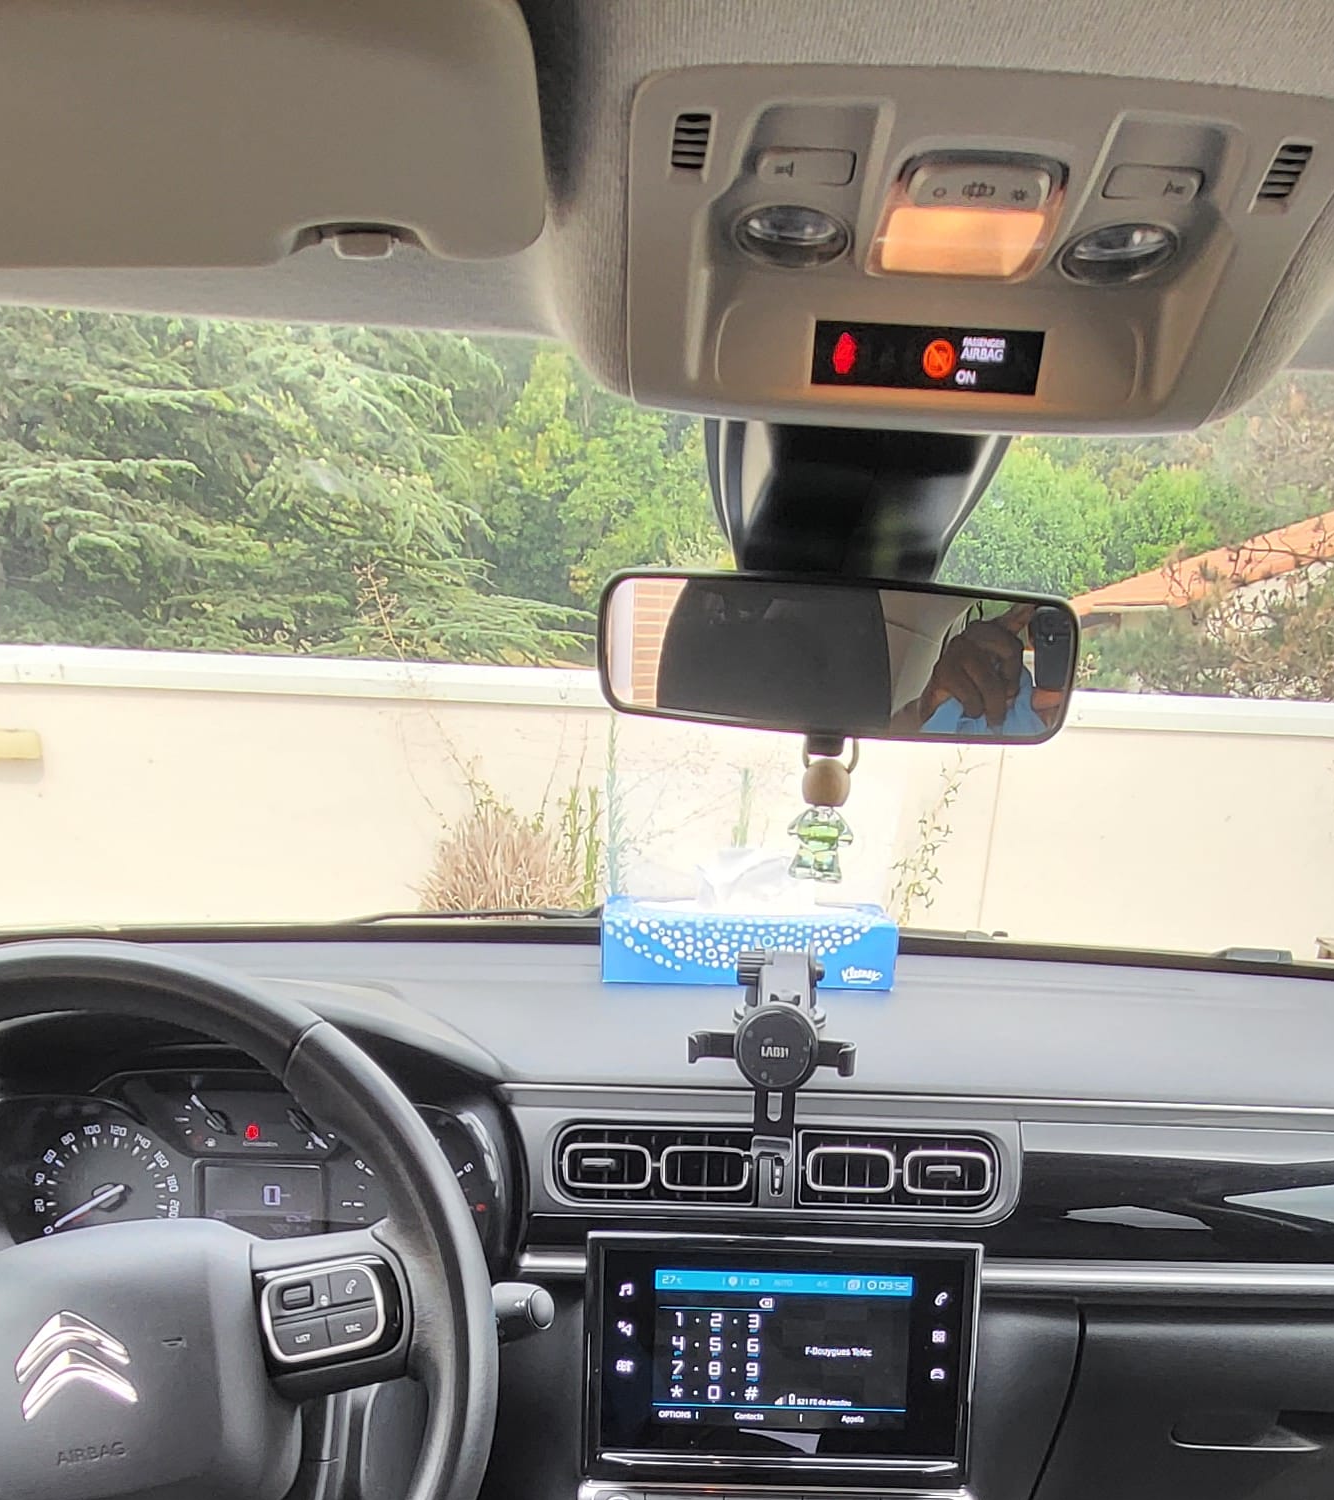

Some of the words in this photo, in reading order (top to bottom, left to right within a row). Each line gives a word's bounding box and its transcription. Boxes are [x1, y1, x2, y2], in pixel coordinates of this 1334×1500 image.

[962, 336, 1006, 348] PASSENGER
[960, 346, 1004, 362] AIRBAG
[955, 369, 976, 385] ON
[841, 966, 883, 982] Kleenex
[83, 1124, 101, 1135] 100
[110, 1125, 127, 1137] 120
[60, 1132, 76, 1146] 80
[135, 1133, 151, 1149] 140
[43, 1149, 57, 1164] 60
[153, 1151, 169, 1168] 160
[35, 1172, 45, 1186] 40
[166, 1175, 179, 1193] 180
[263, 1185, 281, 1206] 0
[34, 1199, 44, 1213] 20
[168, 1199, 180, 1218] 200
[675, 1312, 682, 1327] 1
[710, 1313, 723, 1328] 2
[747, 1313, 760, 1328] 3
[672, 1336, 684, 1351] 4
[709, 1337, 721, 1352] 5
[747, 1338, 759, 1352] 6
[671, 1360, 683, 1374] 7
[709, 1361, 721, 1376] 8
[746, 1362, 758, 1377] 9
[707, 1385, 720, 1400] 0
[658, 1410, 692, 1419] OPTIONS
[56, 1441, 126, 1466] AIRBAG
